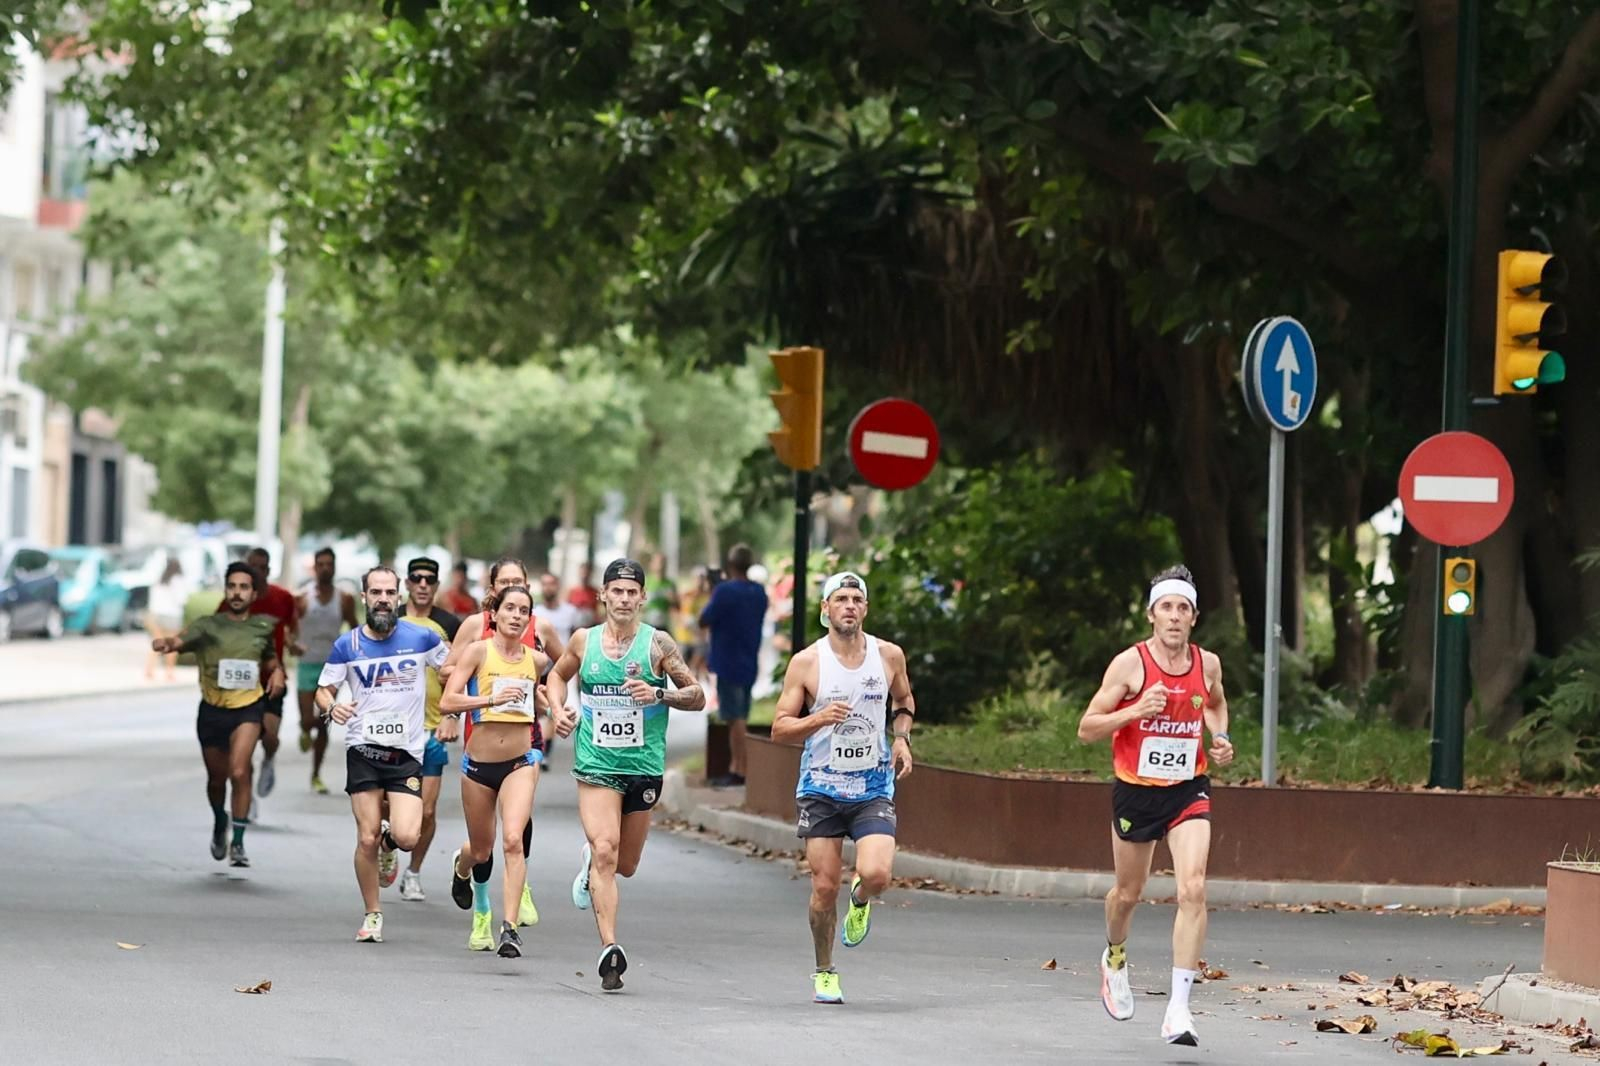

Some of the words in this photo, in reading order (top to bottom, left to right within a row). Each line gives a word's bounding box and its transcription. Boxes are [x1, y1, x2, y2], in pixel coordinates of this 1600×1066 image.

[224, 669, 252, 681] 596
[353, 659, 417, 689] VAS
[367, 723, 404, 735] 1200
[600, 722, 635, 736] 403
[834, 744, 873, 758] 1067
[1148, 751, 1187, 767] 624
